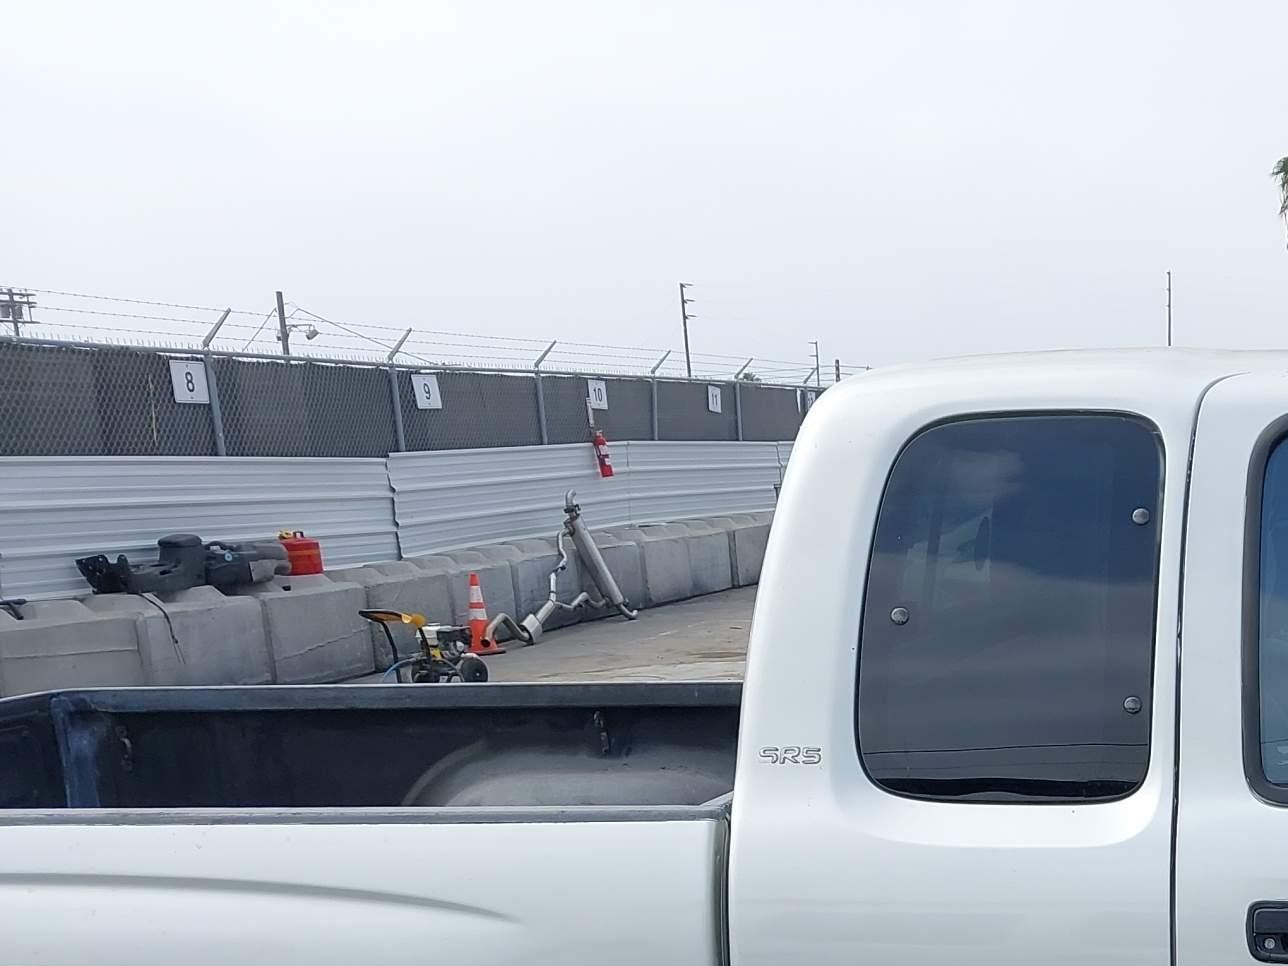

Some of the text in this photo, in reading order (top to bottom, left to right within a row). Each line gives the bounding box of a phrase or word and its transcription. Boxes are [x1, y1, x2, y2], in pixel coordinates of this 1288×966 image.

[185, 371, 195, 393] 8
[423, 382, 431, 400] 9
[593, 387, 603, 402] 10
[759, 746, 822, 765] SR5
